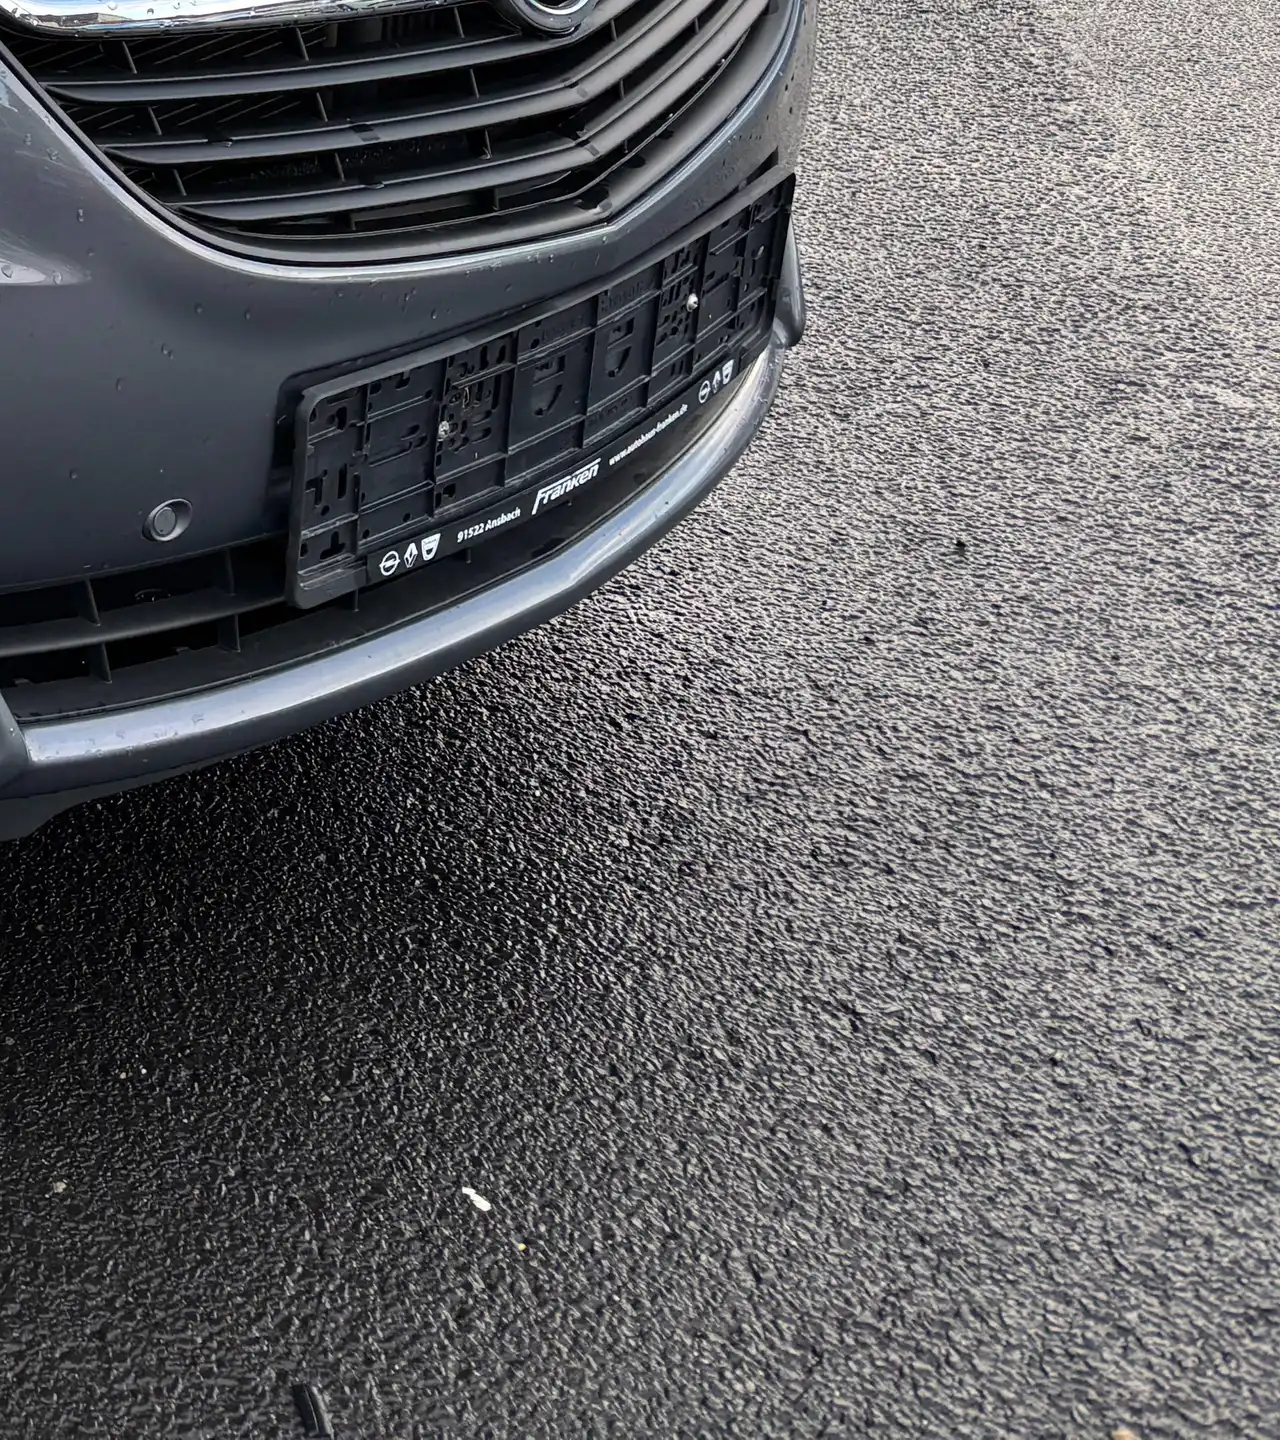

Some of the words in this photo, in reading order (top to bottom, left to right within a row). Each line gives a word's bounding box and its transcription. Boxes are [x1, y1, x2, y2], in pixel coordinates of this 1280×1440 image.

[456, 523, 485, 543] 91522
[485, 506, 521, 531] Ansbach
[531, 457, 602, 515] Franken
